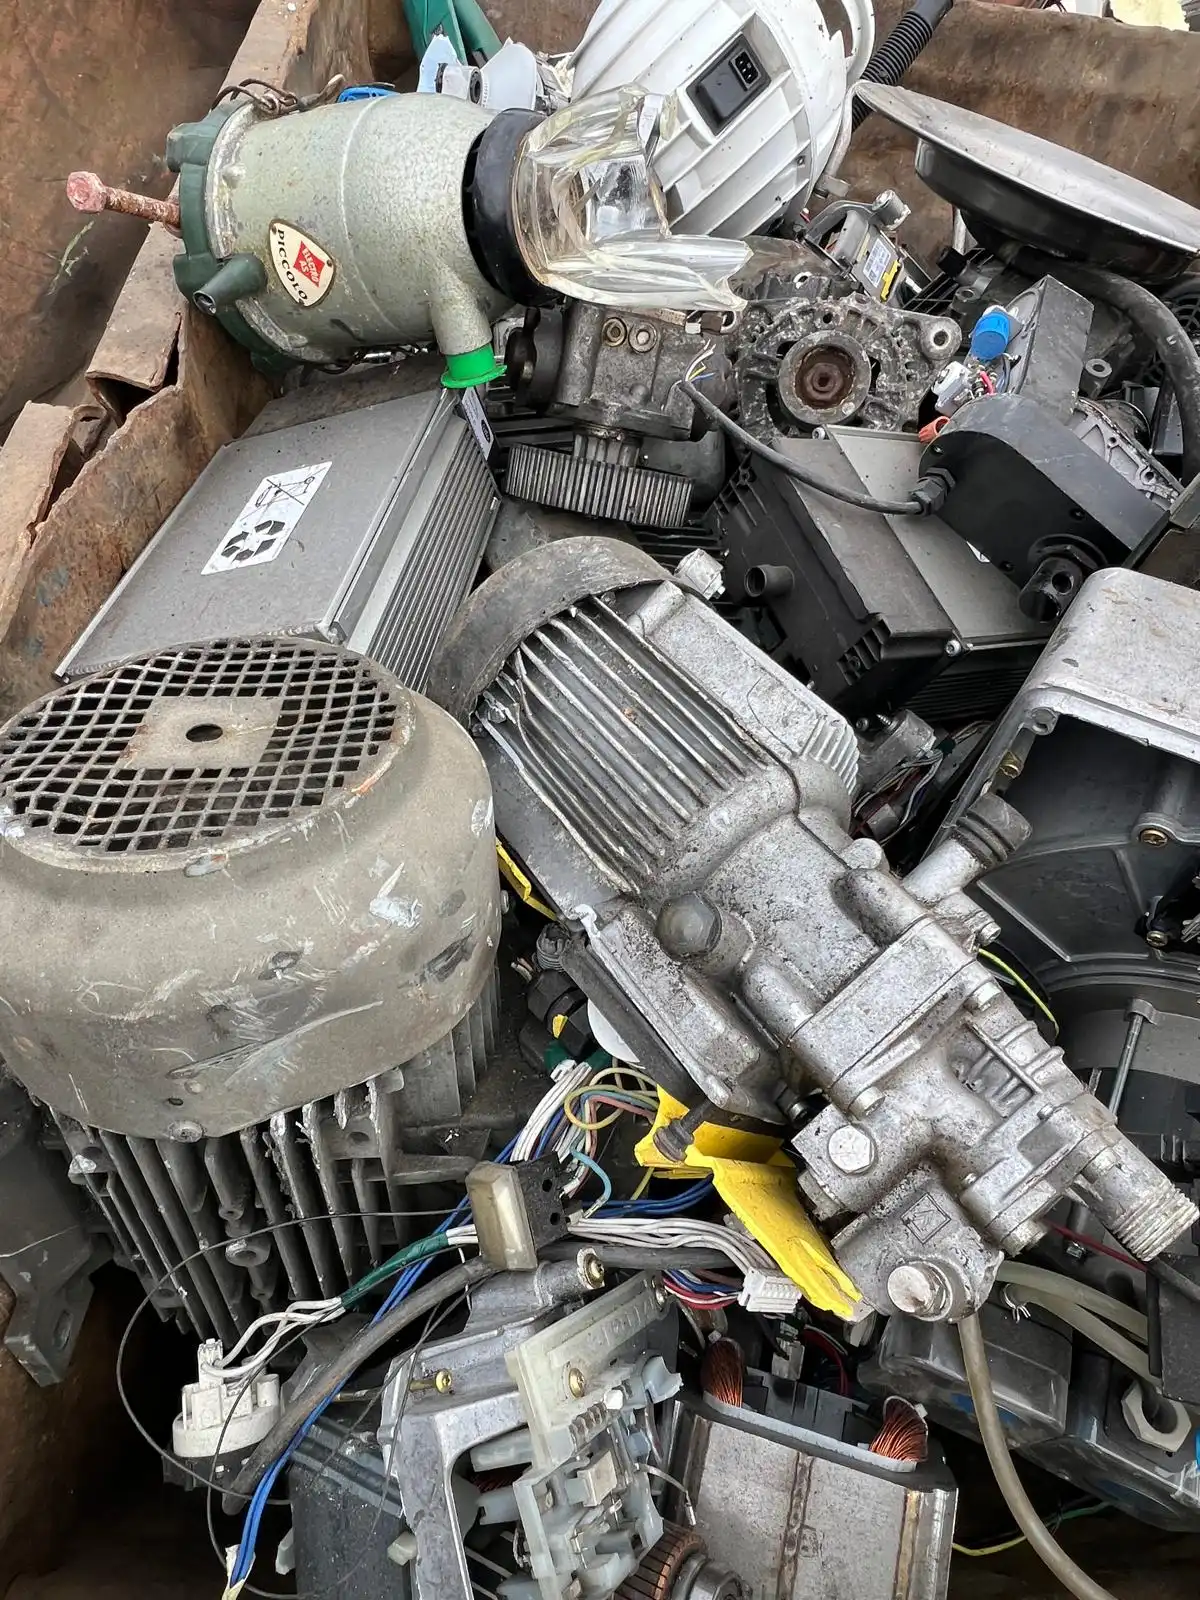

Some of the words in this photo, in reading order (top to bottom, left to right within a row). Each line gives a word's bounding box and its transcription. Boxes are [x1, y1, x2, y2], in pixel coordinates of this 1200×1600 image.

[278, 229, 308, 300] PICCOLO
[299, 260, 309, 273] AS
[302, 248, 319, 283] ELECTRO
